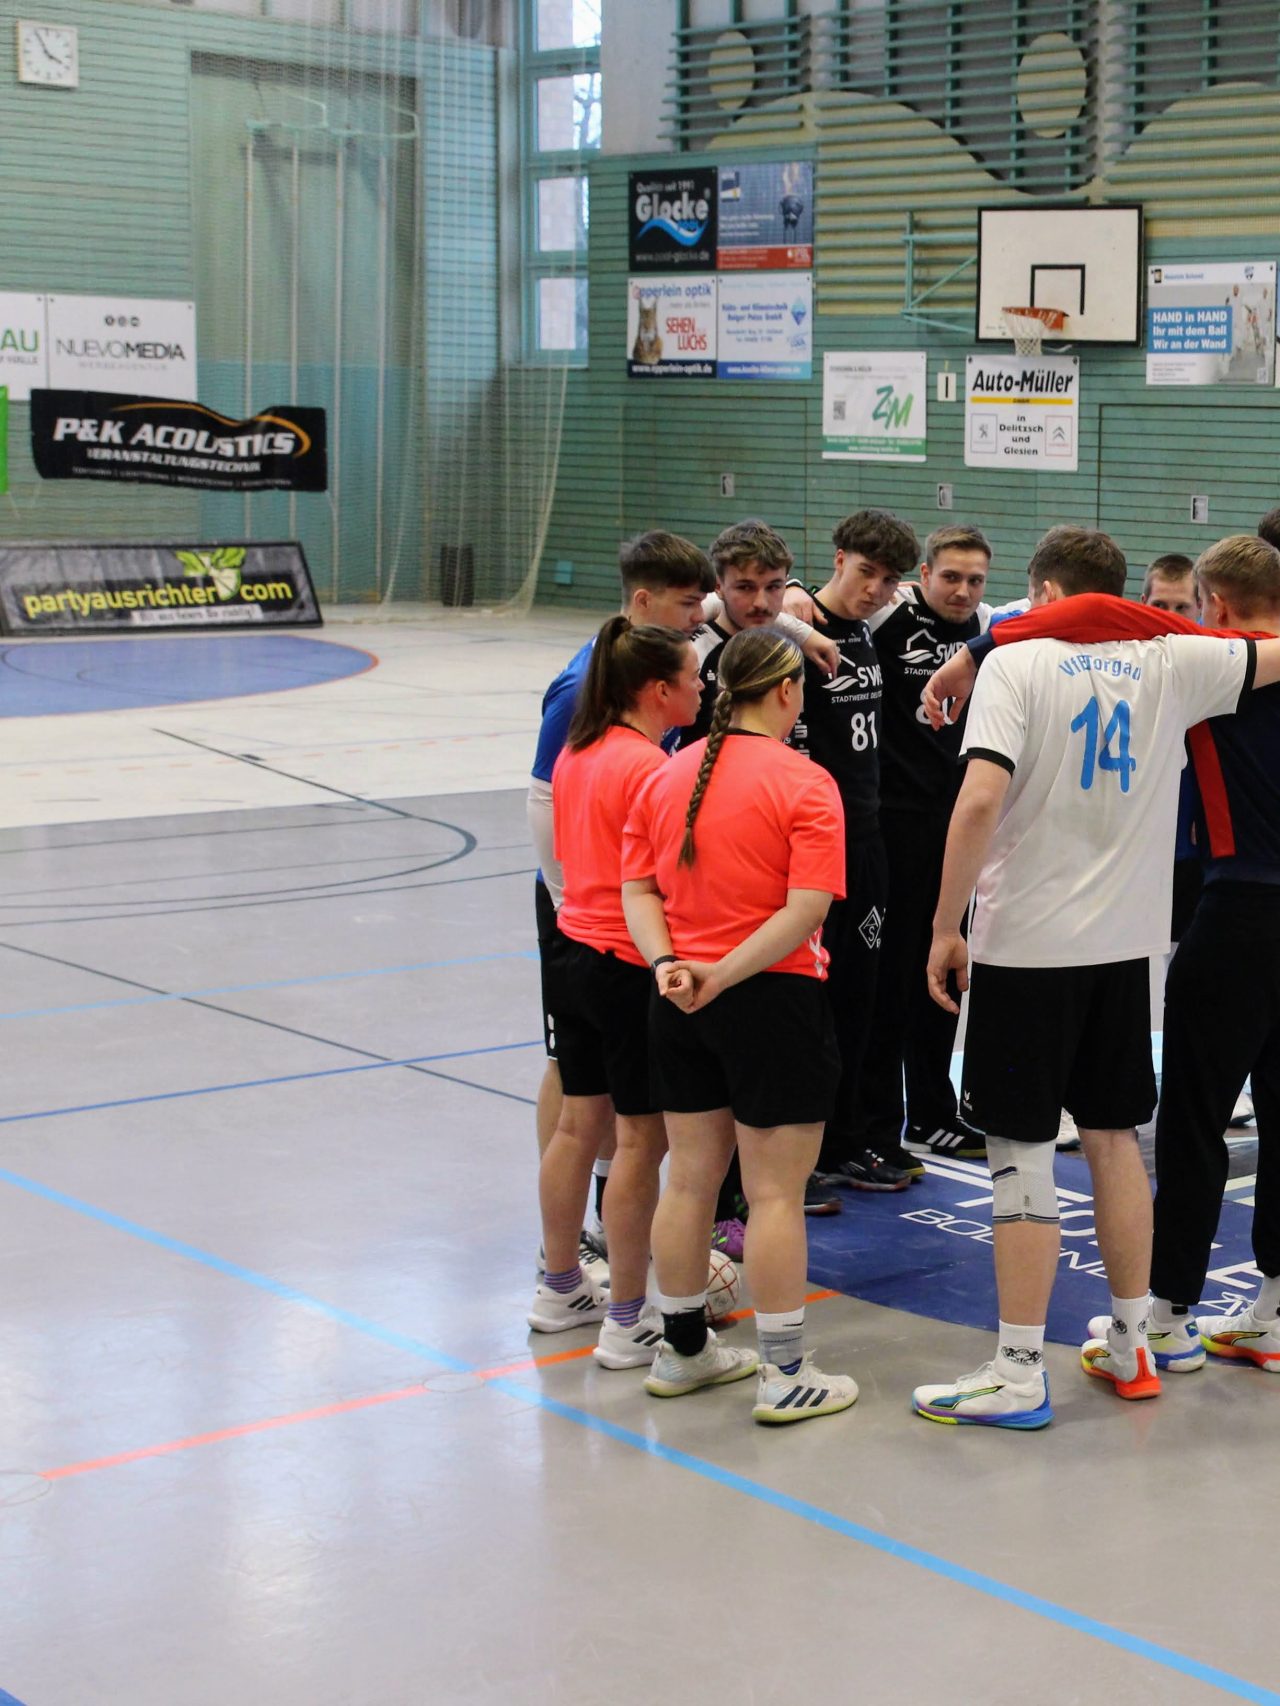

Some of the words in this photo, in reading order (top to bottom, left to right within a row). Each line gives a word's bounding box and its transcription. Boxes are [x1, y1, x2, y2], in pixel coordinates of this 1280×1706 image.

[636, 192, 709, 222] Glocke
[685, 281, 712, 297] optik
[1153, 312, 1182, 322] HAND
[1185, 312, 1194, 321] in
[1197, 311, 1227, 321] HAND
[666, 317, 695, 333] SEHEN
[1153, 327, 1165, 336] Ihr
[1168, 327, 1183, 336] mit
[1185, 326, 1205, 336] dem
[1208, 325, 1227, 335] Ball
[56, 339, 186, 360] NUEVOMEDIA
[678, 334, 707, 350] LUCHS
[1153, 340, 1168, 349] Wir
[1170, 341, 1182, 349] an
[1184, 340, 1199, 349] der
[1201, 339, 1227, 349] Wand
[972, 368, 1074, 393] Auto-Müller
[999, 424, 1044, 433] Delitzsch
[53, 417, 125, 443] P&K
[130, 423, 296, 457] ACOUSTICS
[1003, 447, 1039, 455] Glesien
[86, 447, 262, 473] VERANSTALTUNGSTECHNIK
[24, 584, 216, 618] partyausrichter
[831, 692, 869, 703] STADTWERKE
[851, 711, 878, 751] 81
[1071, 695, 1136, 793] 14
